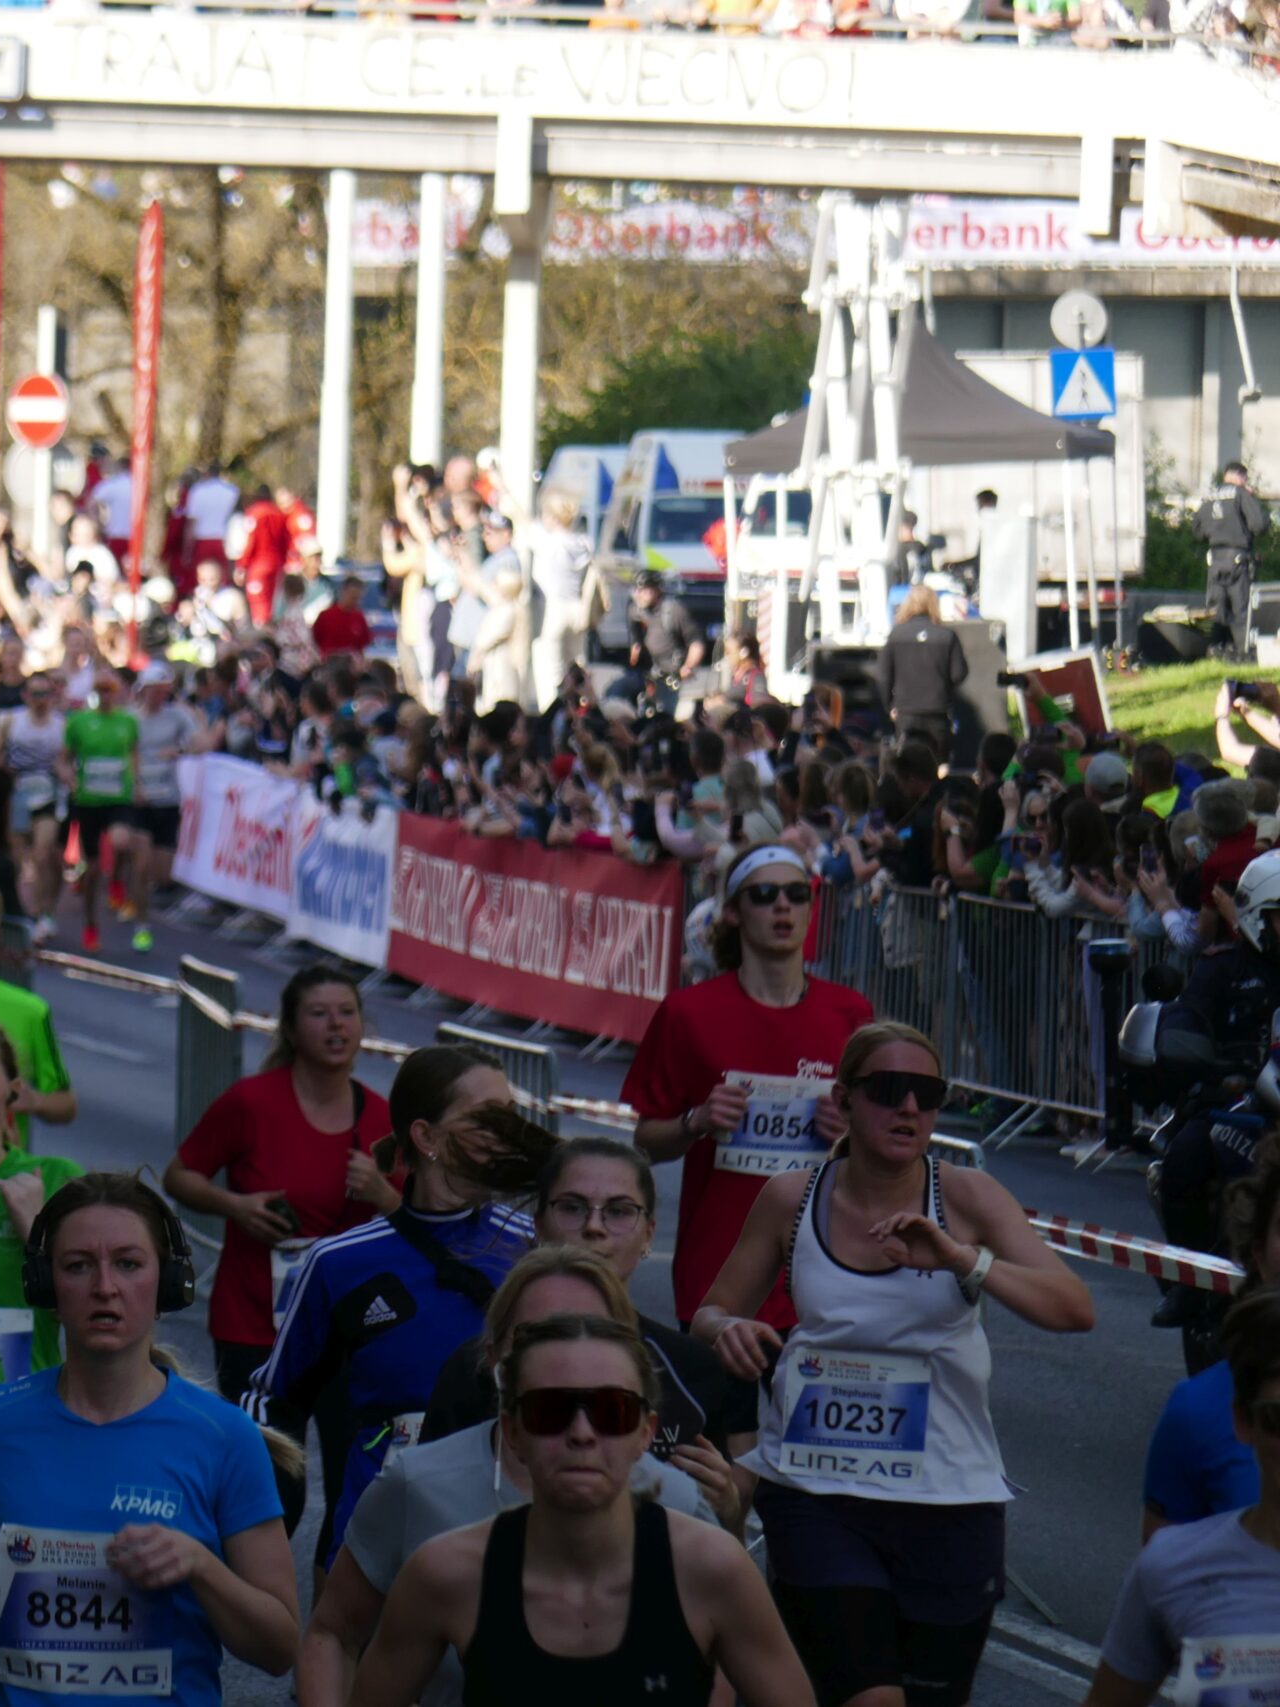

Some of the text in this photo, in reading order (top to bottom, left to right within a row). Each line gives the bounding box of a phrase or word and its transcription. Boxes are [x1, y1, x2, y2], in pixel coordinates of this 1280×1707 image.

[550, 208, 775, 251] Oberbank
[912, 209, 1070, 251] erbank
[742, 1111, 817, 1140] 10854
[362, 1309, 398, 1327] adidas
[831, 1386, 882, 1401] Stephanie
[804, 1397, 908, 1436] 10237
[865, 1460, 913, 1479] AG
[109, 1495, 178, 1519] KPMG
[56, 1576, 107, 1591] Melanie
[26, 1590, 133, 1633] 8844
[100, 1664, 159, 1686] AG
